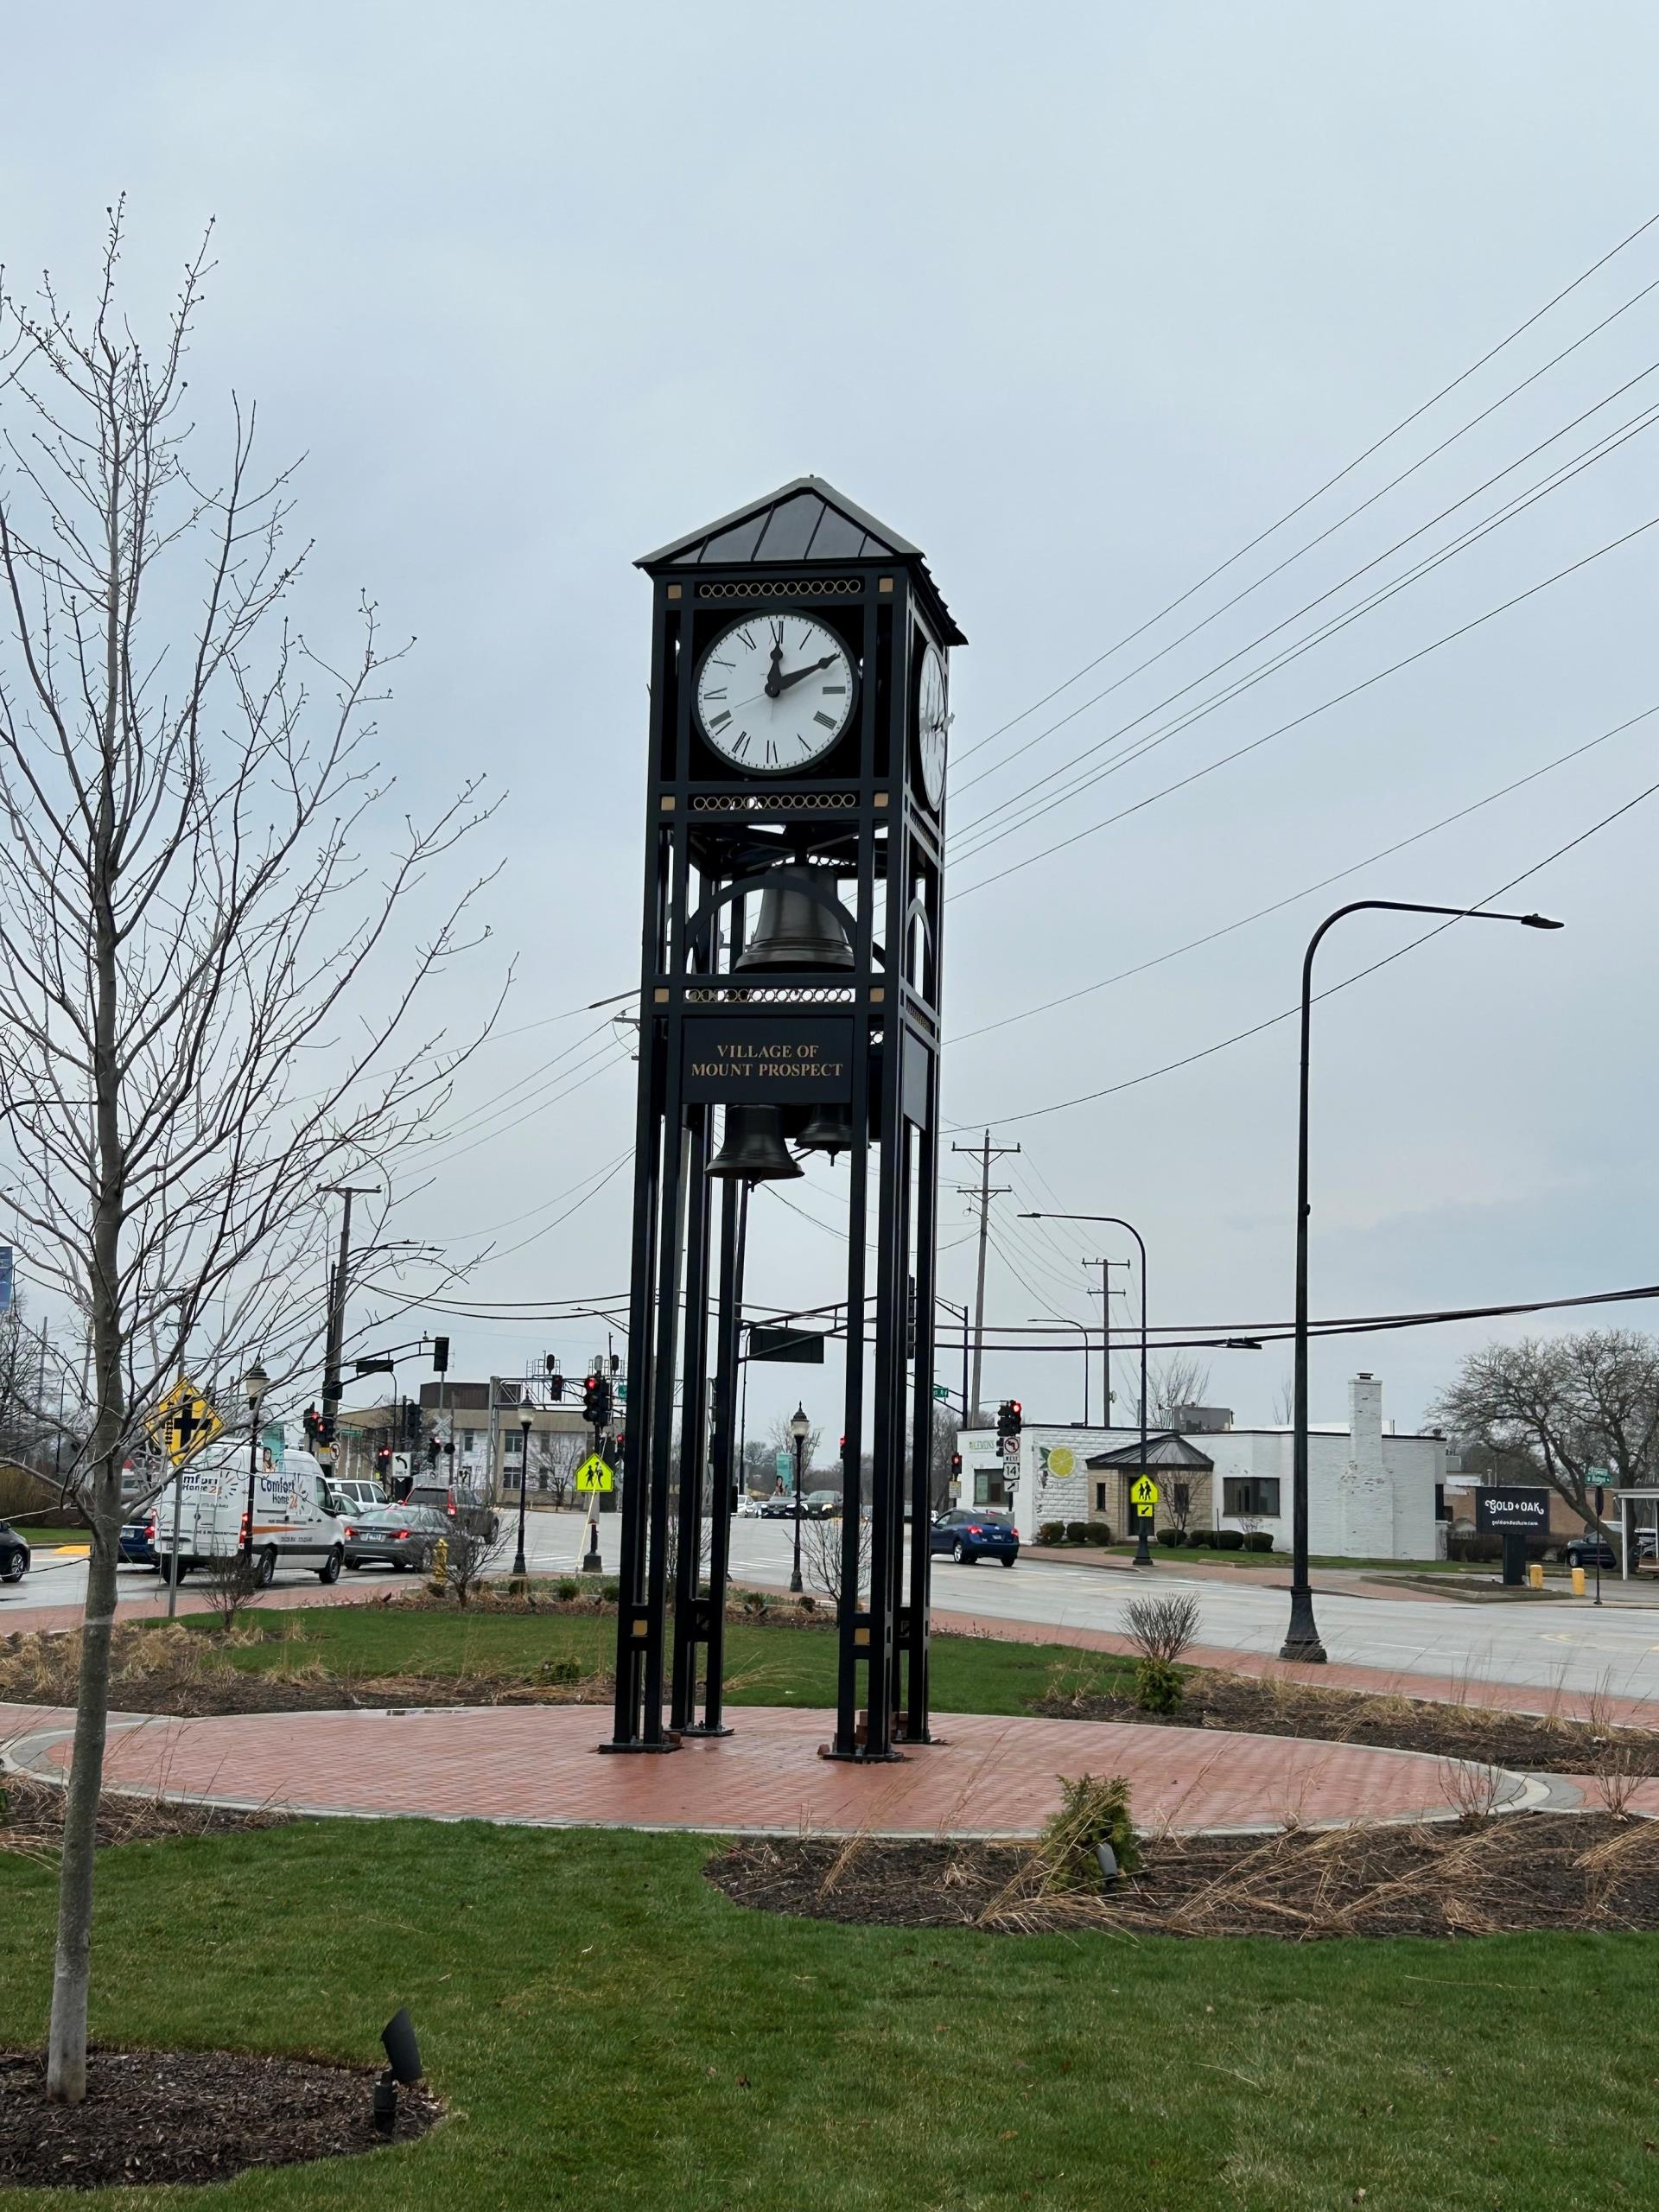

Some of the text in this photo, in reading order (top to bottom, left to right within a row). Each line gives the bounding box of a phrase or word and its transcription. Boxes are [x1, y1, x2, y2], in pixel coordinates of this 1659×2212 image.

[716, 1045, 819, 1058] VILLAGE OF
[691, 1064, 843, 1077] MOUNT PROSPECT
[1007, 1465, 1017, 1476] 14
[260, 1476, 296, 1494] Comfort
[272, 1492, 290, 1504] Home
[1484, 1499, 1544, 1515] GOLD OAK
